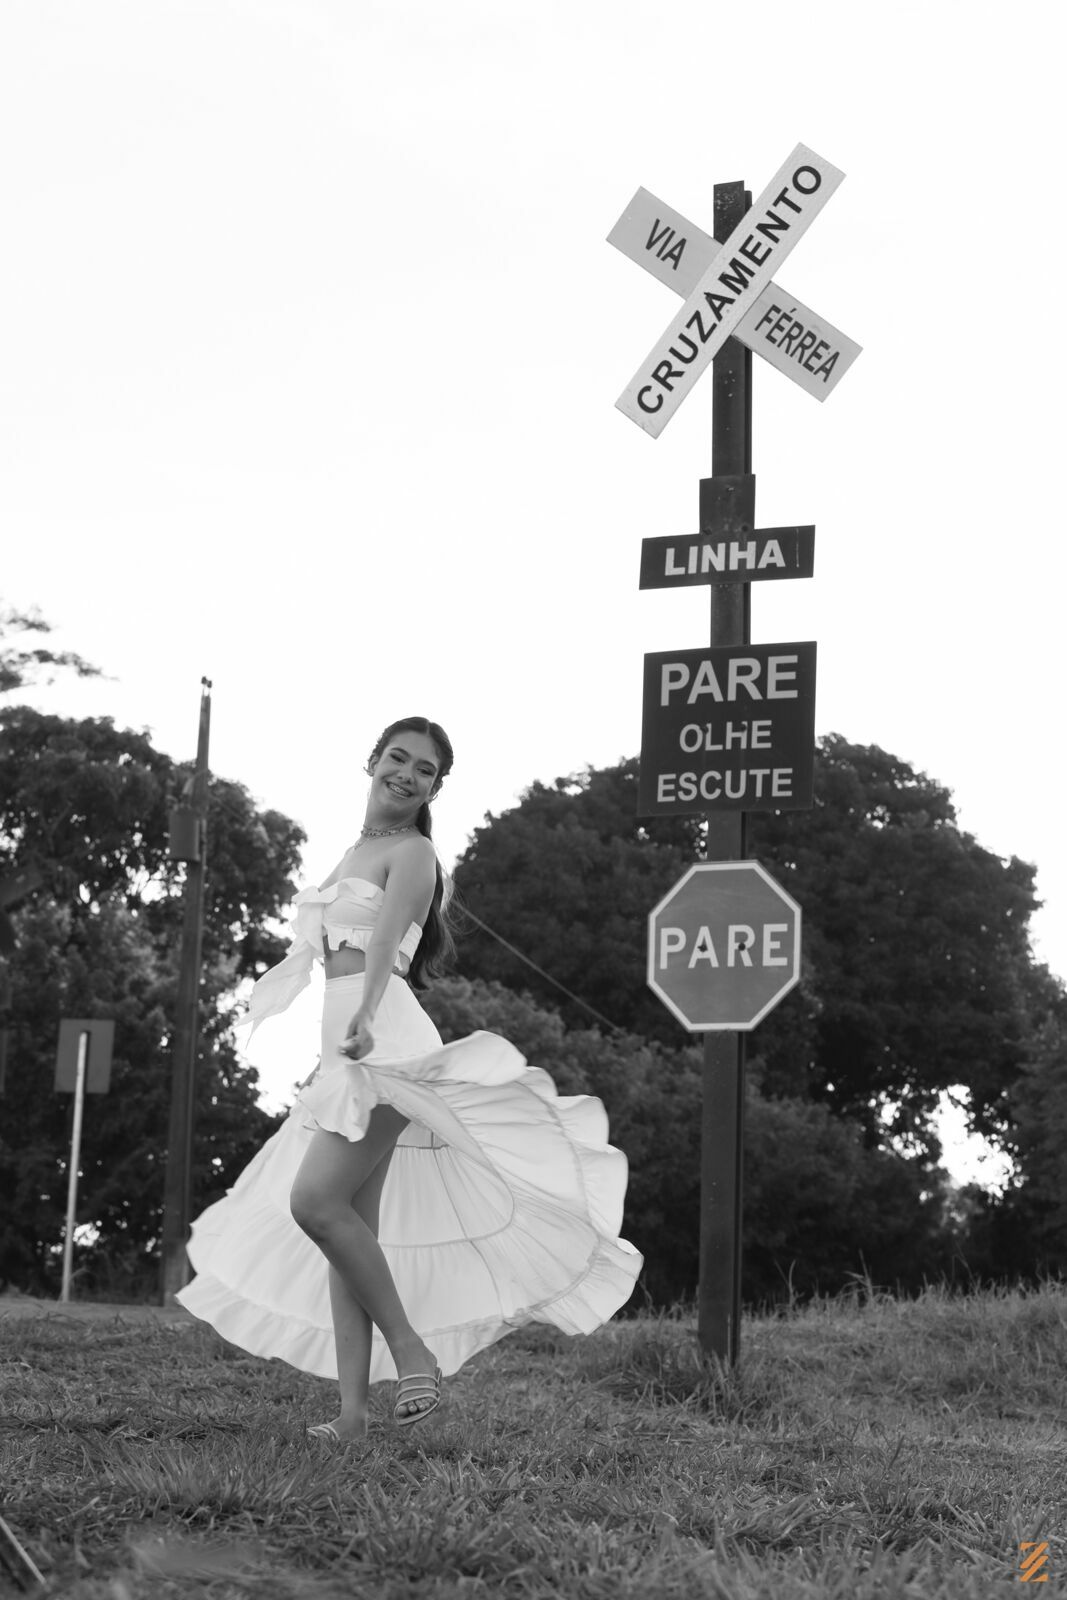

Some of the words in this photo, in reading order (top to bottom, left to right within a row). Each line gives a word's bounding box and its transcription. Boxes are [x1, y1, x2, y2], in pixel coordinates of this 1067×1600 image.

[636, 165, 821, 414] CRUZAMENTO
[645, 218, 686, 270] VIA
[754, 307, 840, 383] FÉRREA
[665, 540, 786, 576] LINHA
[661, 655, 798, 706] PARE
[679, 720, 772, 752] OLHE
[657, 768, 793, 802] ESCUTE
[659, 923, 788, 970] PARE
